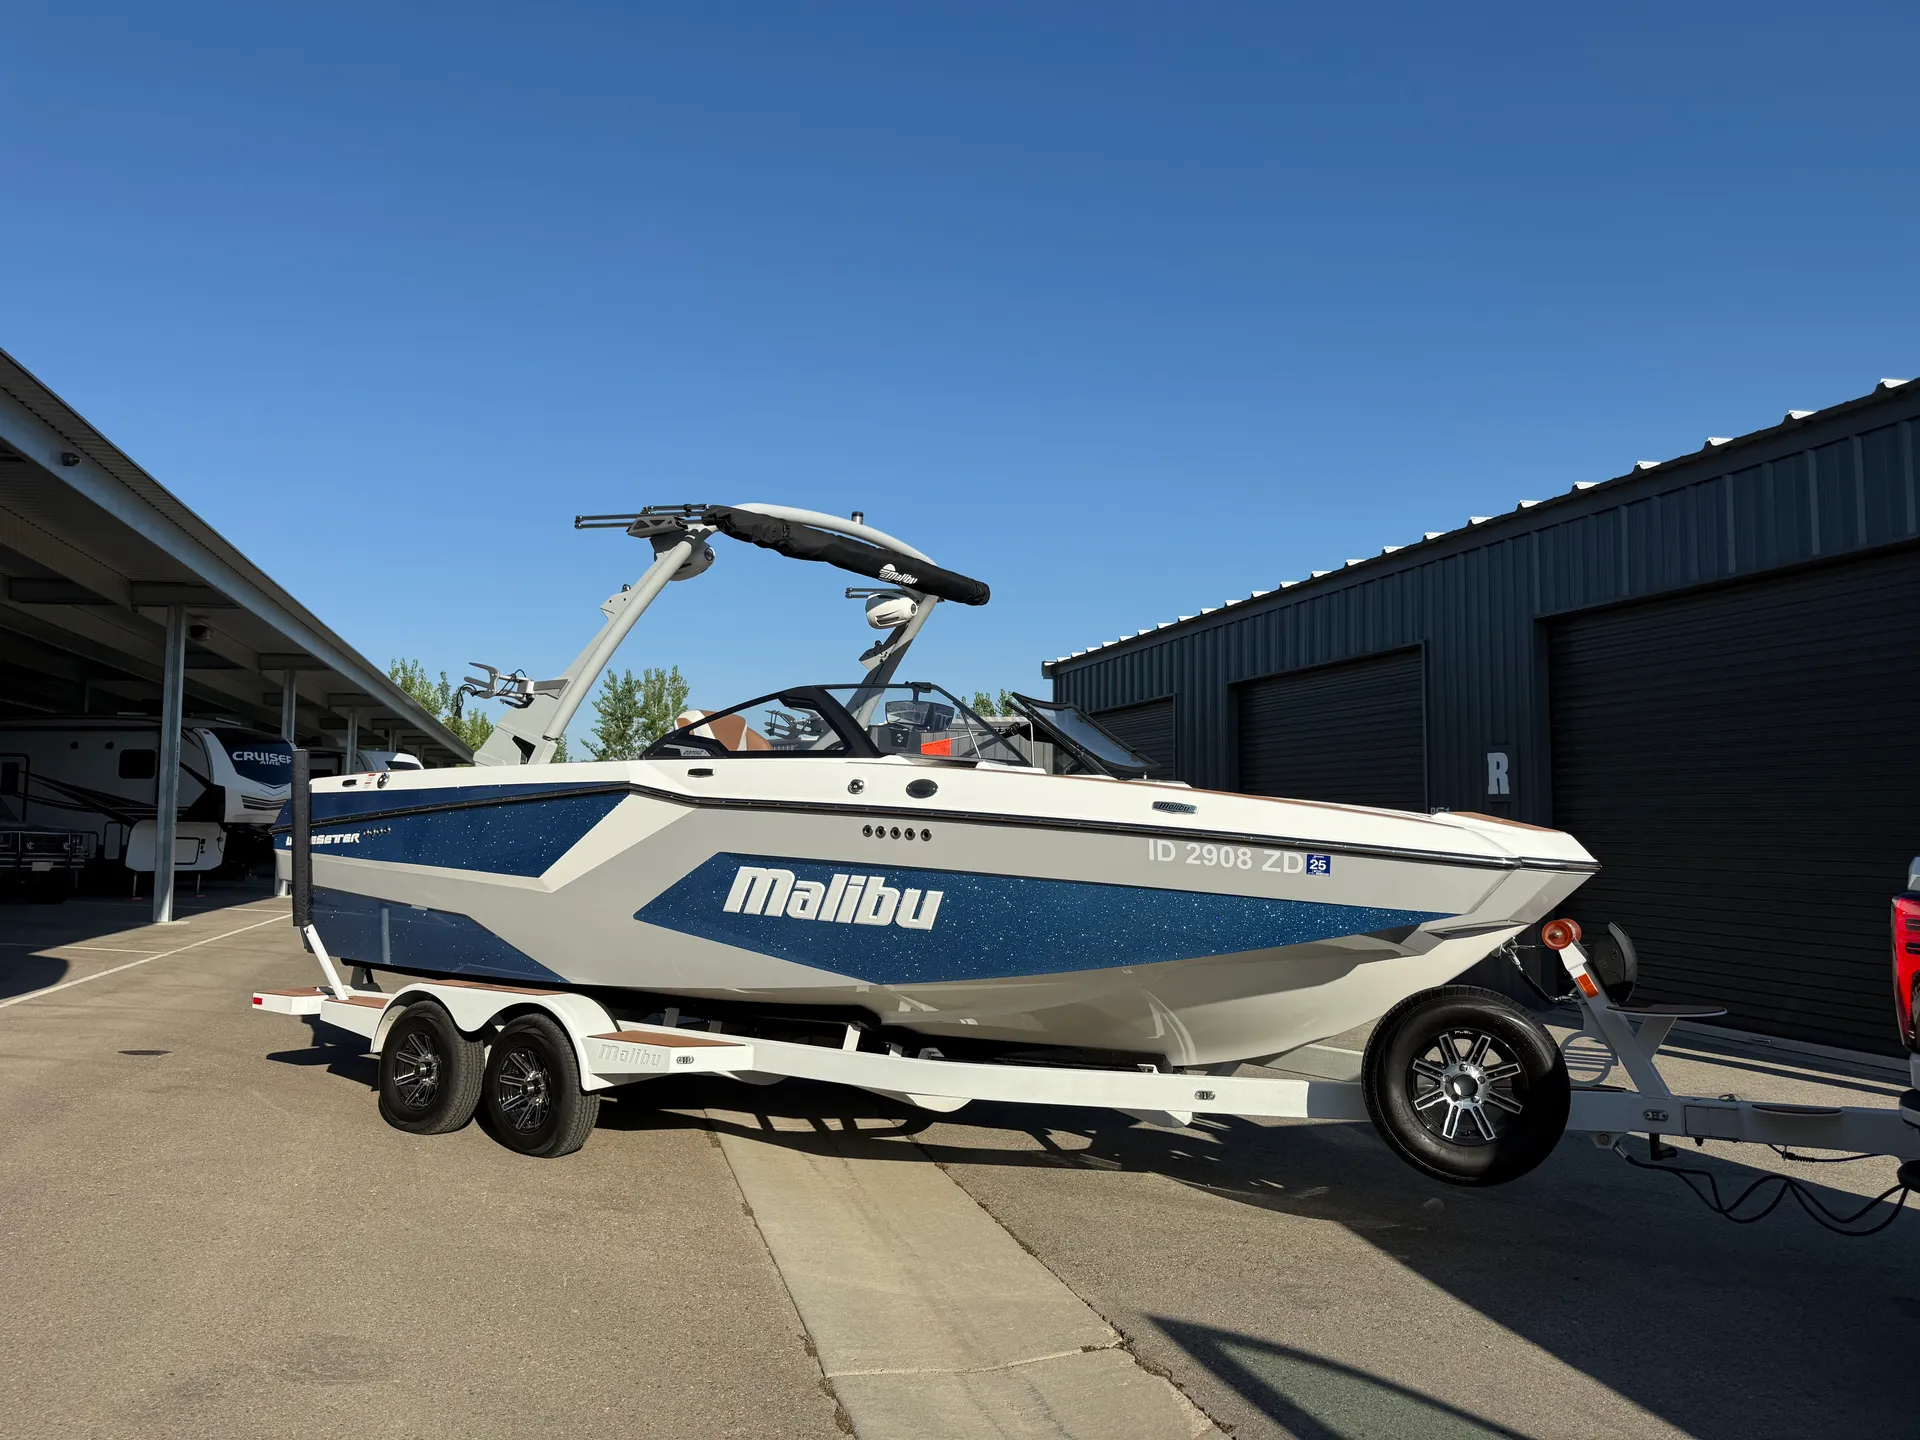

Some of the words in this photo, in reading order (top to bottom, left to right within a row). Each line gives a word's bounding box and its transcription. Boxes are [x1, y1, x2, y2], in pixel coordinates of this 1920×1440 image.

[884, 571, 918, 584] Malibu
[1487, 752, 1509, 794] R
[1159, 802, 1191, 811] Malibu
[1148, 839, 1176, 862] ID
[1185, 843, 1253, 870] 2908
[1262, 850, 1304, 874] ZD
[1310, 859, 1326, 870] 25
[722, 866, 944, 930] Malibu
[598, 1044, 661, 1067] Malibu
